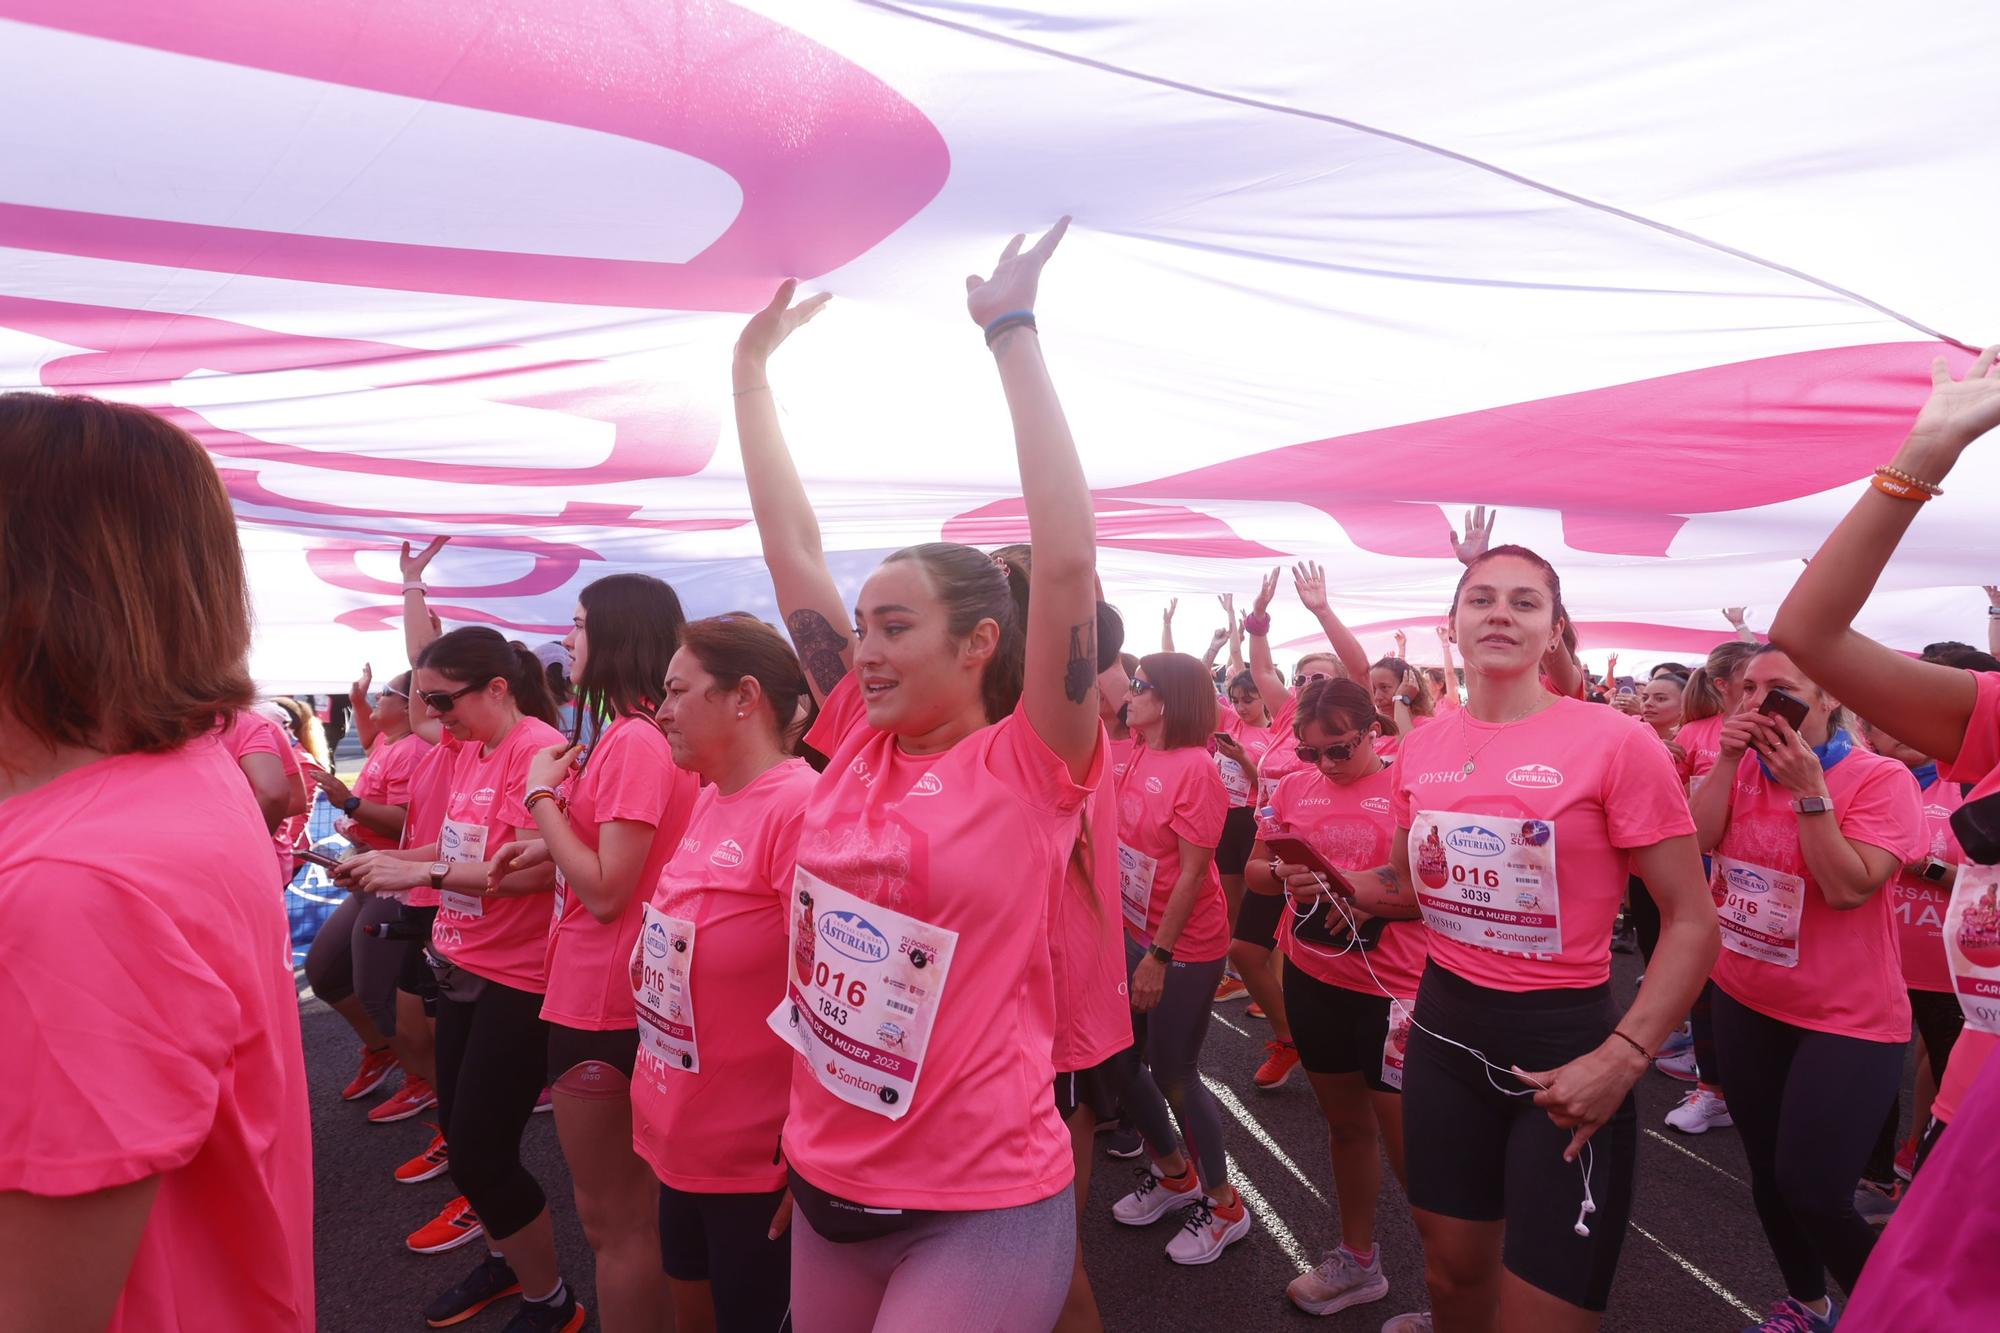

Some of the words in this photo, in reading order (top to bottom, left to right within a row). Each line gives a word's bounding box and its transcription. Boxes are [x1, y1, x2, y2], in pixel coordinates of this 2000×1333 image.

[1418, 771, 1467, 785] OYSHO
[1509, 771, 1558, 785] ASTURIANA
[1450, 833, 1500, 852] ASTURIANA
[1452, 865, 1500, 888] 016
[1461, 888, 1491, 903] 3039
[1728, 894, 1758, 915] 016
[1427, 898, 1461, 912] CARRERA
[1461, 906, 1472, 914] DE
[1474, 909, 1485, 918] LA
[1486, 911, 1517, 923] MUJER
[1520, 915, 1542, 925] 2023
[1732, 911, 1747, 923] 128
[821, 917, 881, 958] ASTURIANA
[901, 936, 911, 944] TU
[1496, 930, 1548, 944] Santander
[898, 943, 935, 965] SUA
[645, 965, 664, 992] 016
[816, 961, 868, 1007] 016
[819, 997, 848, 1026] 1843
[813, 1018, 824, 1035] DE
[823, 1029, 835, 1044] LA
[834, 1037, 871, 1061] MUJER
[872, 1054, 901, 1072] 2023
